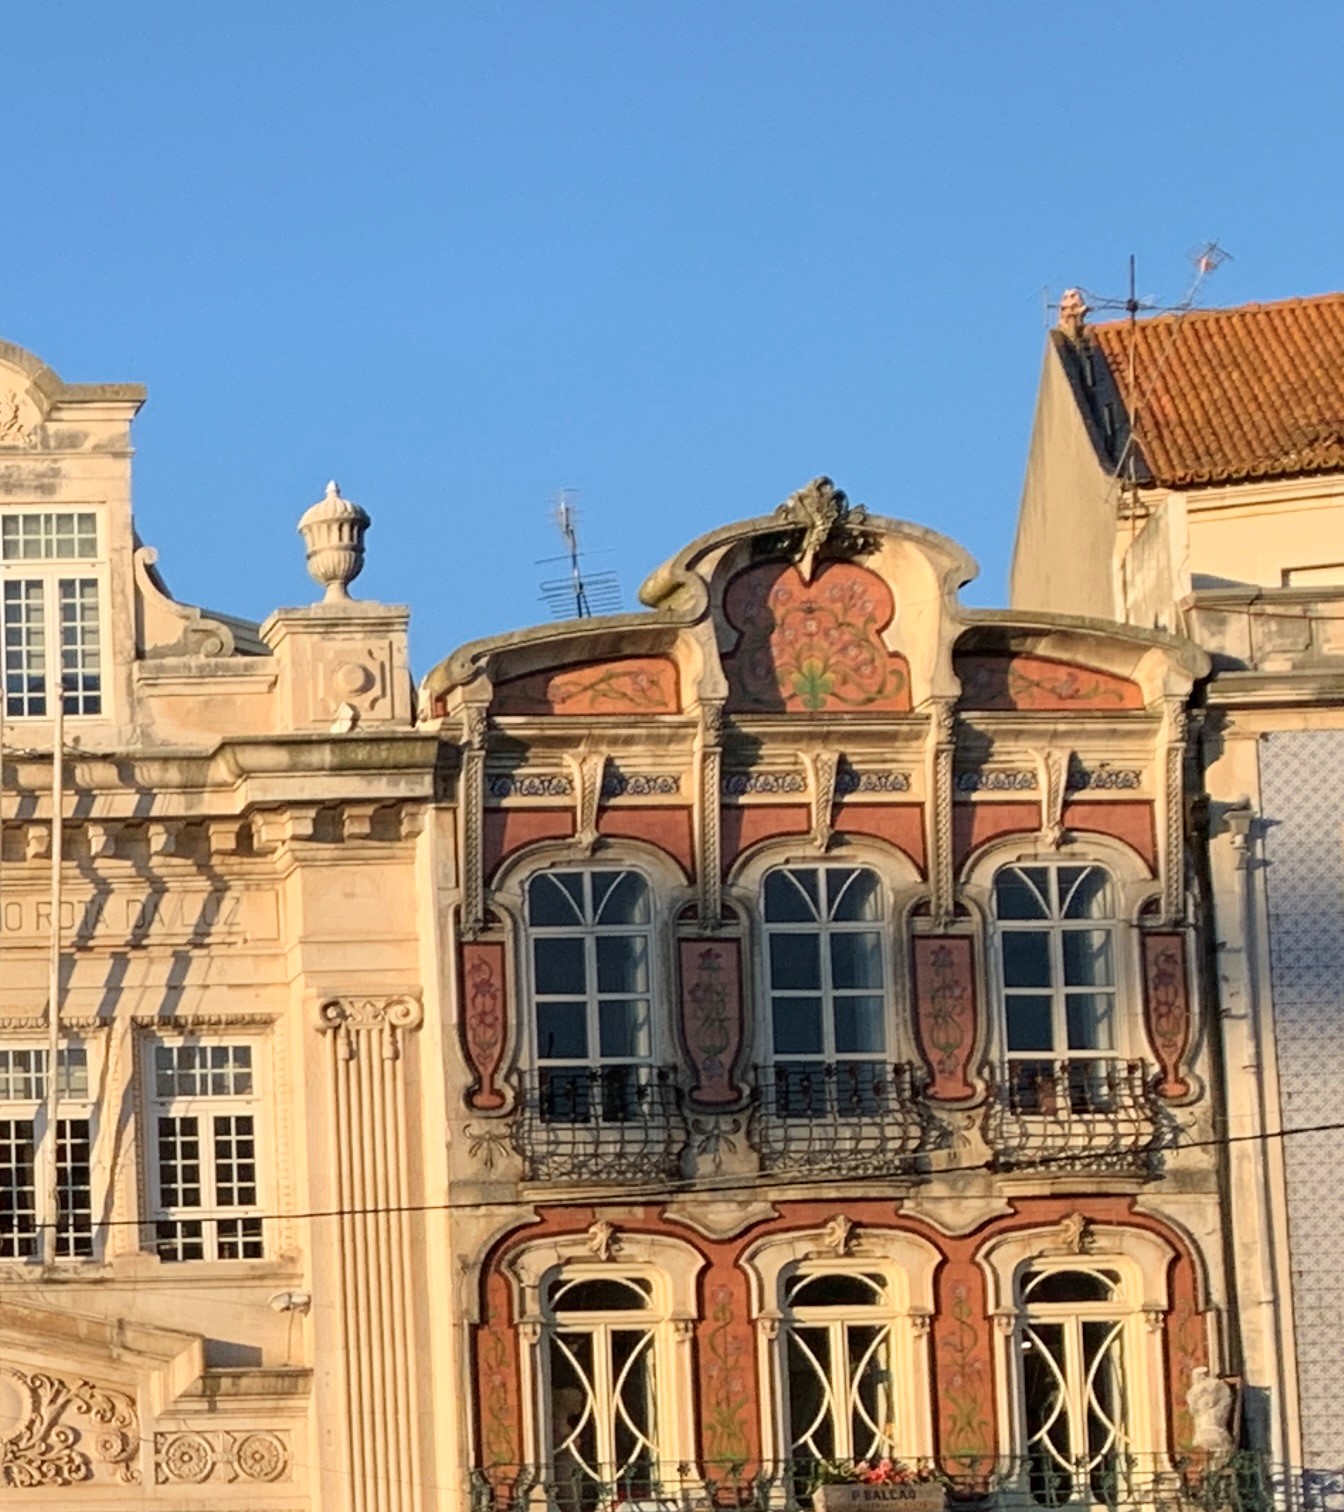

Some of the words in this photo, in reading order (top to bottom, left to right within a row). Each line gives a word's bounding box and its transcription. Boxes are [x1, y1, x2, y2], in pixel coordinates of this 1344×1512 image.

[36, 900, 109, 931] ROTA
[126, 899, 165, 929] DA
[181, 896, 241, 928] LUZ
